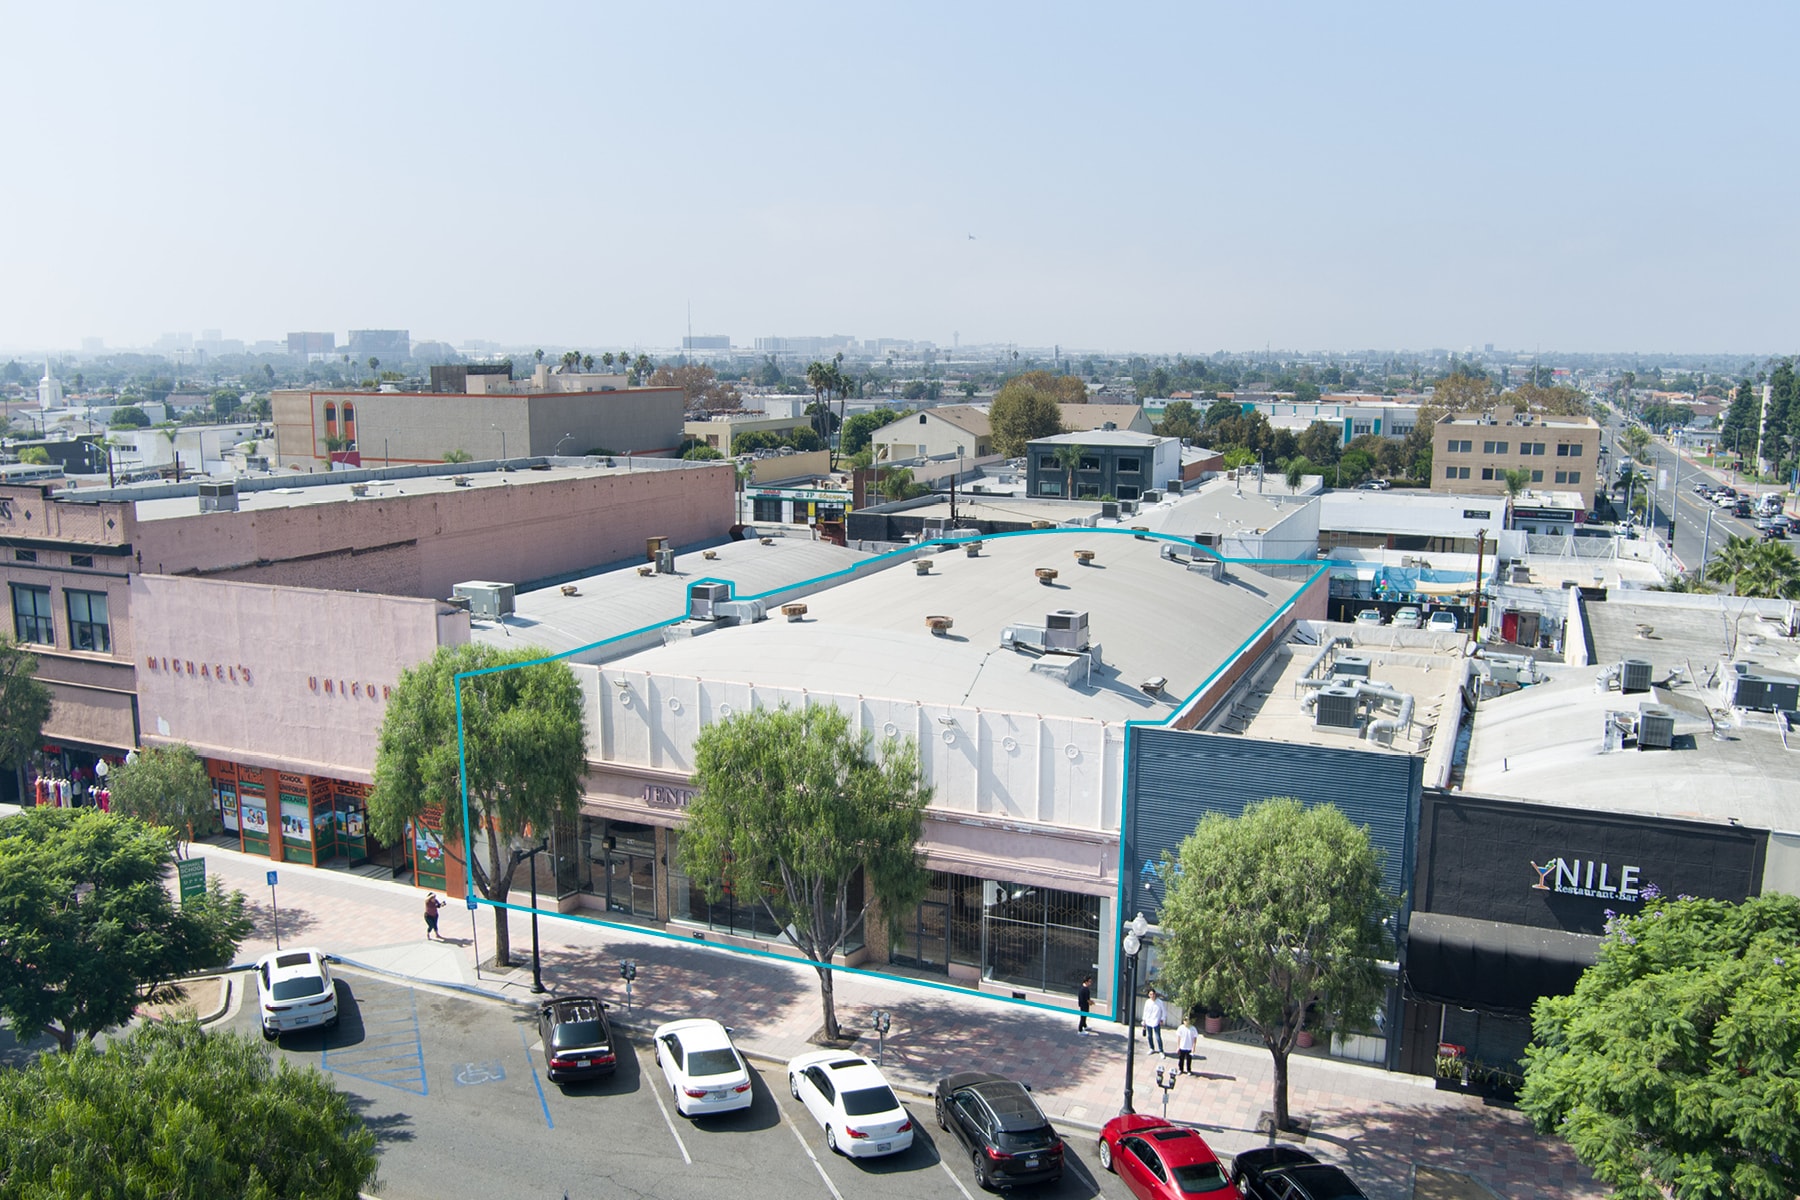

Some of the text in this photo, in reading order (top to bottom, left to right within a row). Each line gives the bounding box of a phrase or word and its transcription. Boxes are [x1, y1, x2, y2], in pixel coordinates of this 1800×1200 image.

[147, 656, 251, 682] MICHAEL'S
[280, 774, 303, 784] SCHOOL
[180, 866, 204, 874] SCHOOL
[1555, 857, 1640, 895] NILE
[1555, 884, 1615, 899] Restaurant
